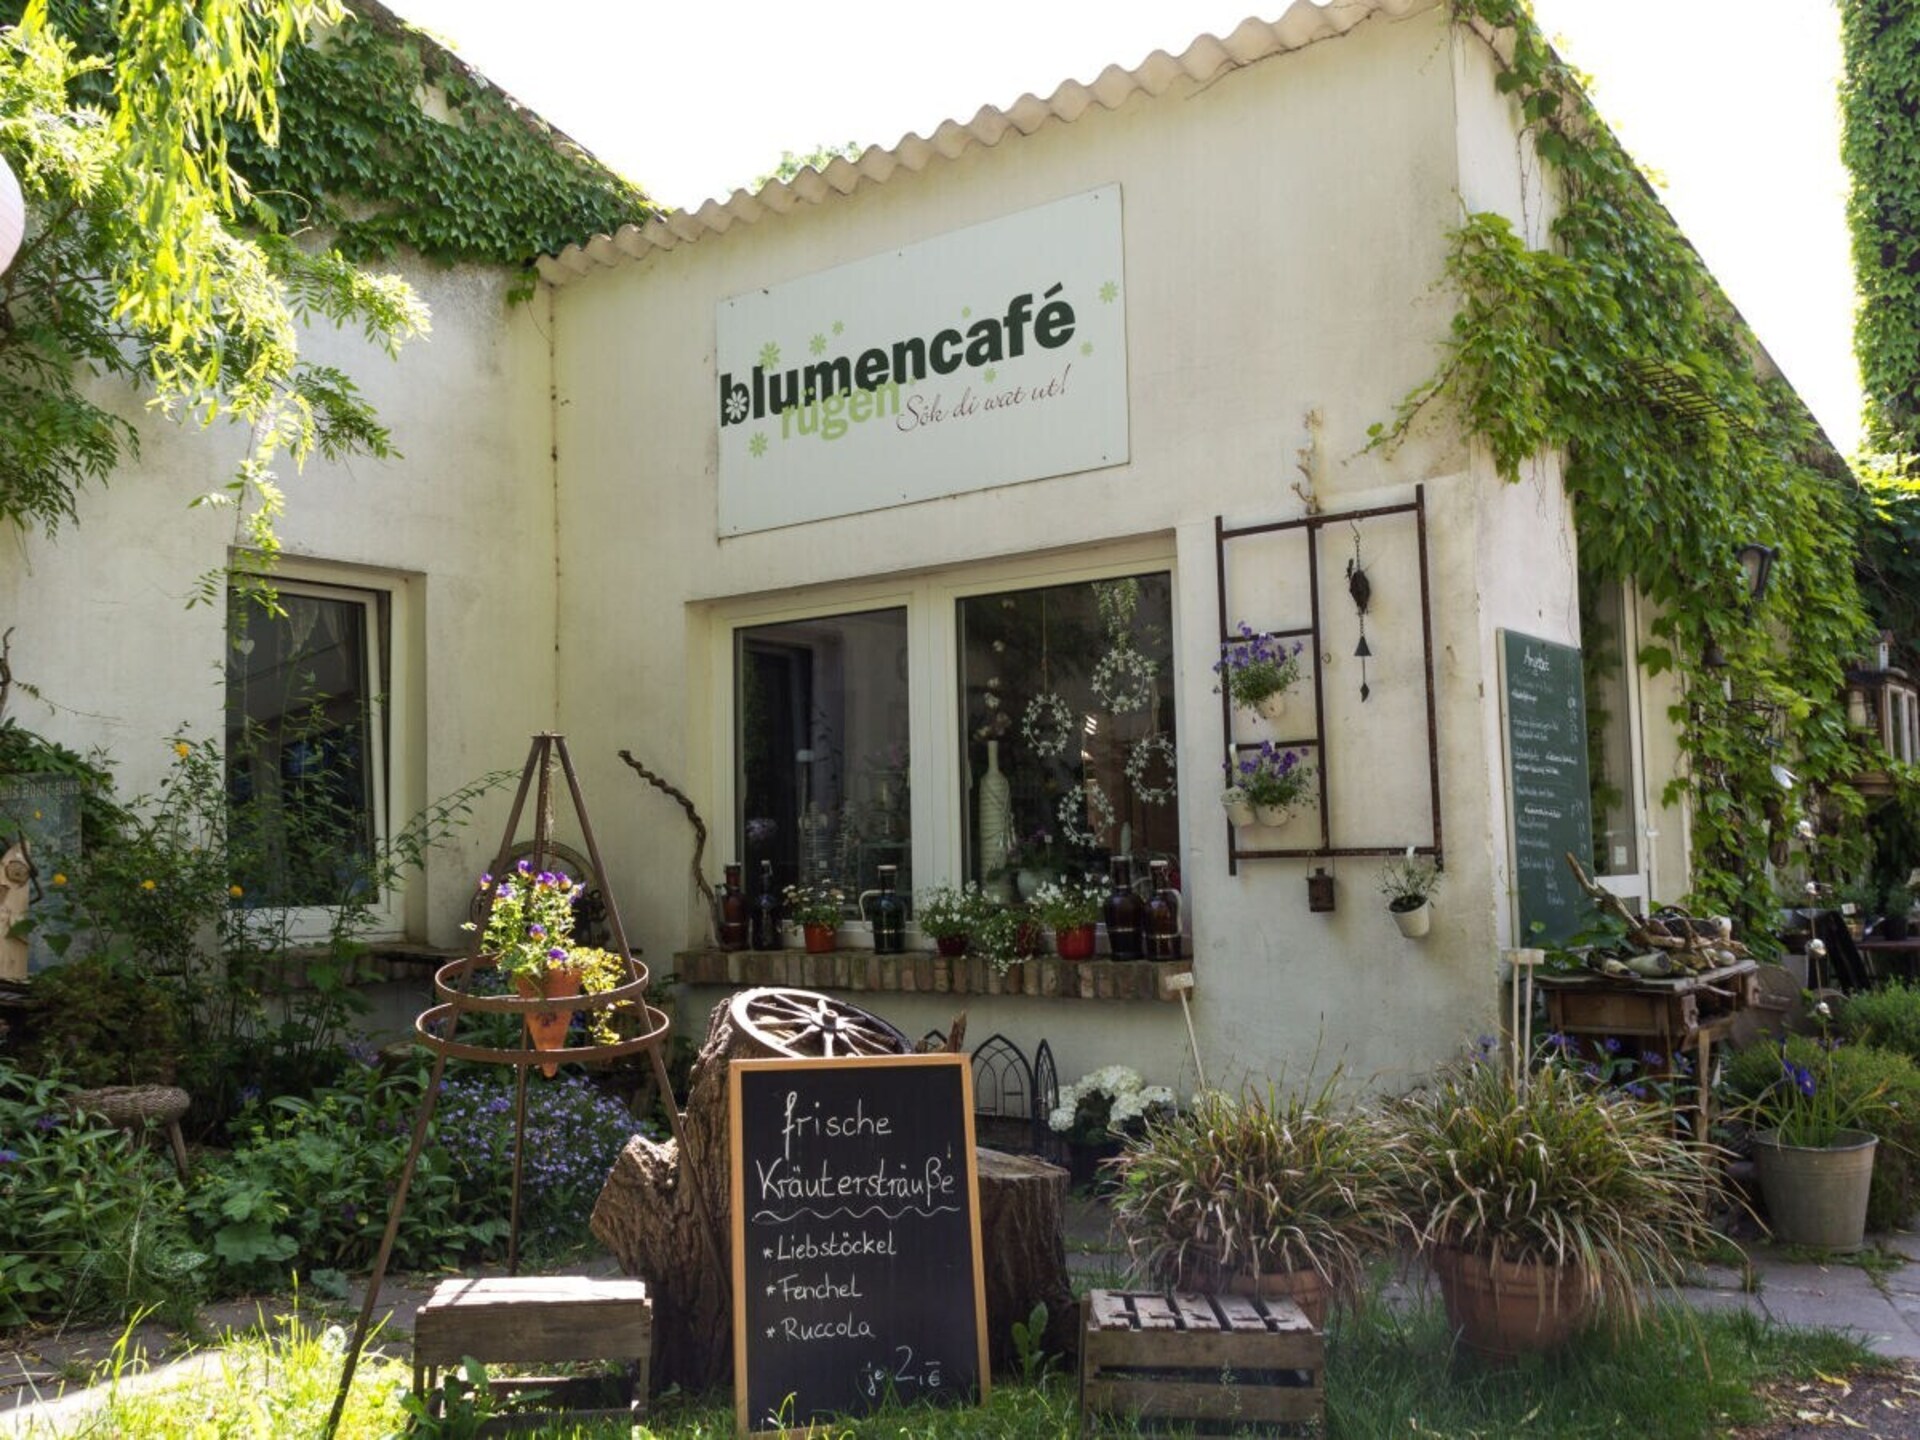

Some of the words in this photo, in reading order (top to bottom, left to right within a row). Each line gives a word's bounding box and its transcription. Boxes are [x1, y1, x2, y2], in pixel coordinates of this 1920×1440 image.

[720, 282, 1076, 428] blumencafé
[953, 386, 976, 418] di
[985, 386, 1024, 411] wat
[1032, 364, 1071, 400] ut!
[782, 1091, 892, 1160] frische
[868, 1361, 885, 1396] je
